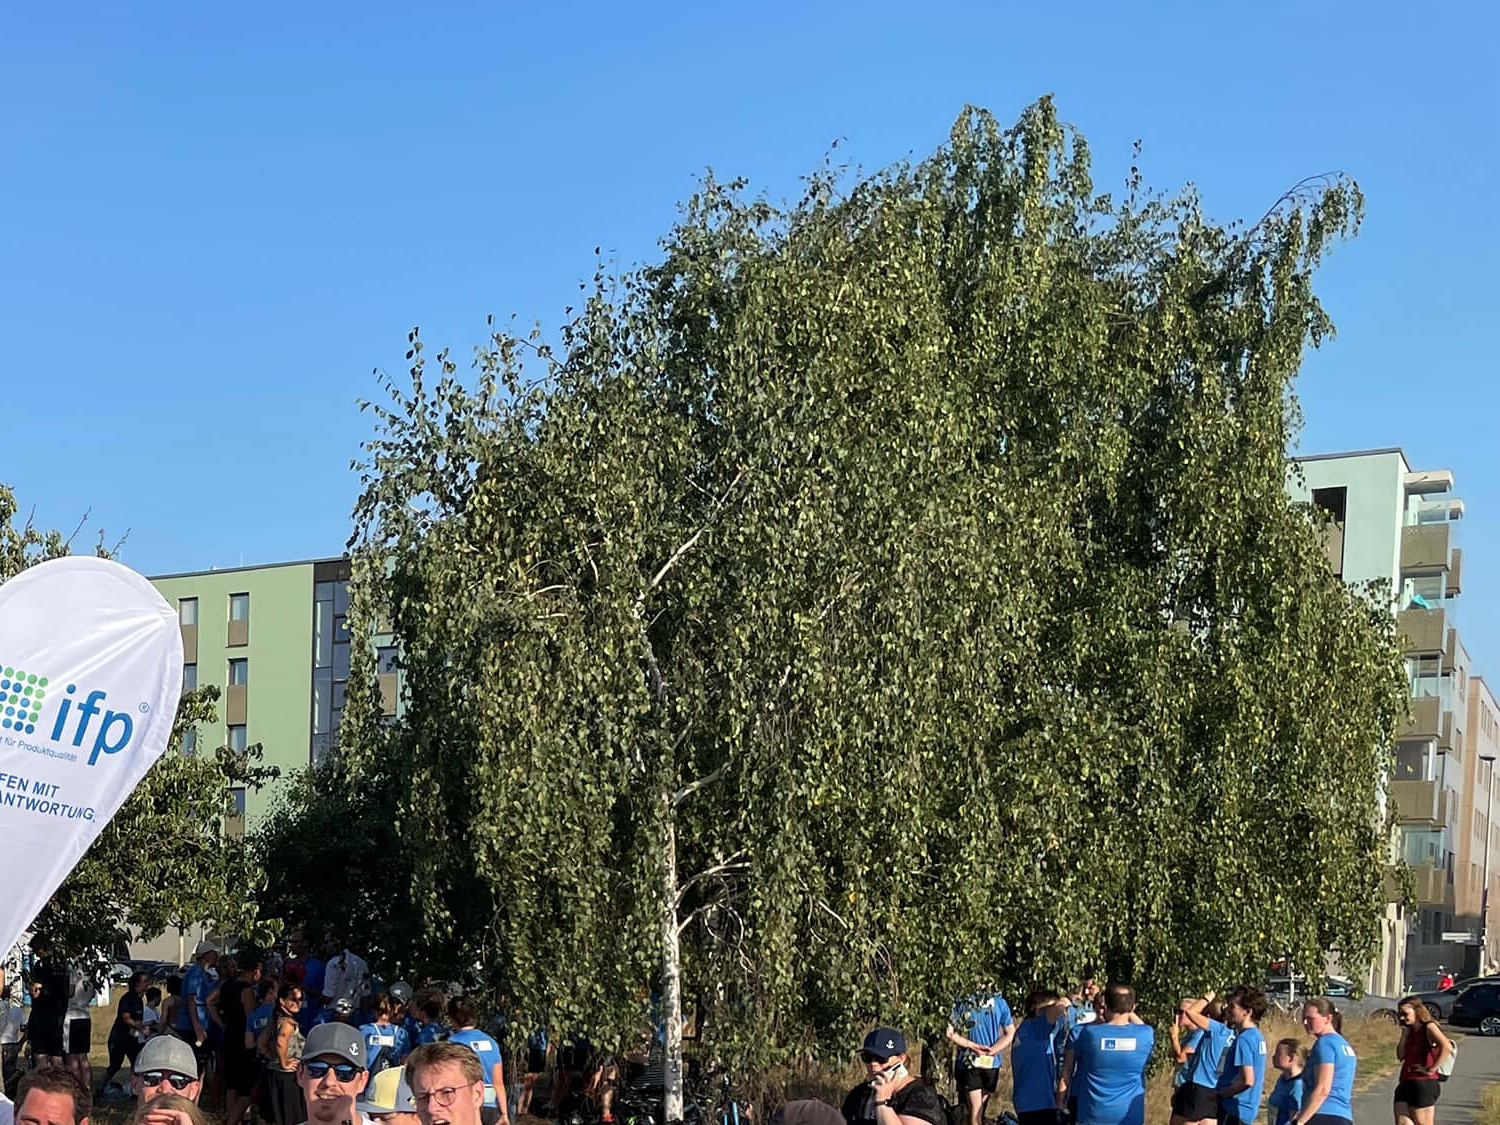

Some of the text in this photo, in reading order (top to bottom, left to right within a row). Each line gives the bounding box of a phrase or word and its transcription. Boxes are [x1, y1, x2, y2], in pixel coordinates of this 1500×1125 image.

[51, 684, 134, 766] ifp
[4, 735, 17, 747] für
[18, 740, 78, 762] Produktqualität
[32, 781, 60, 798] MIT
